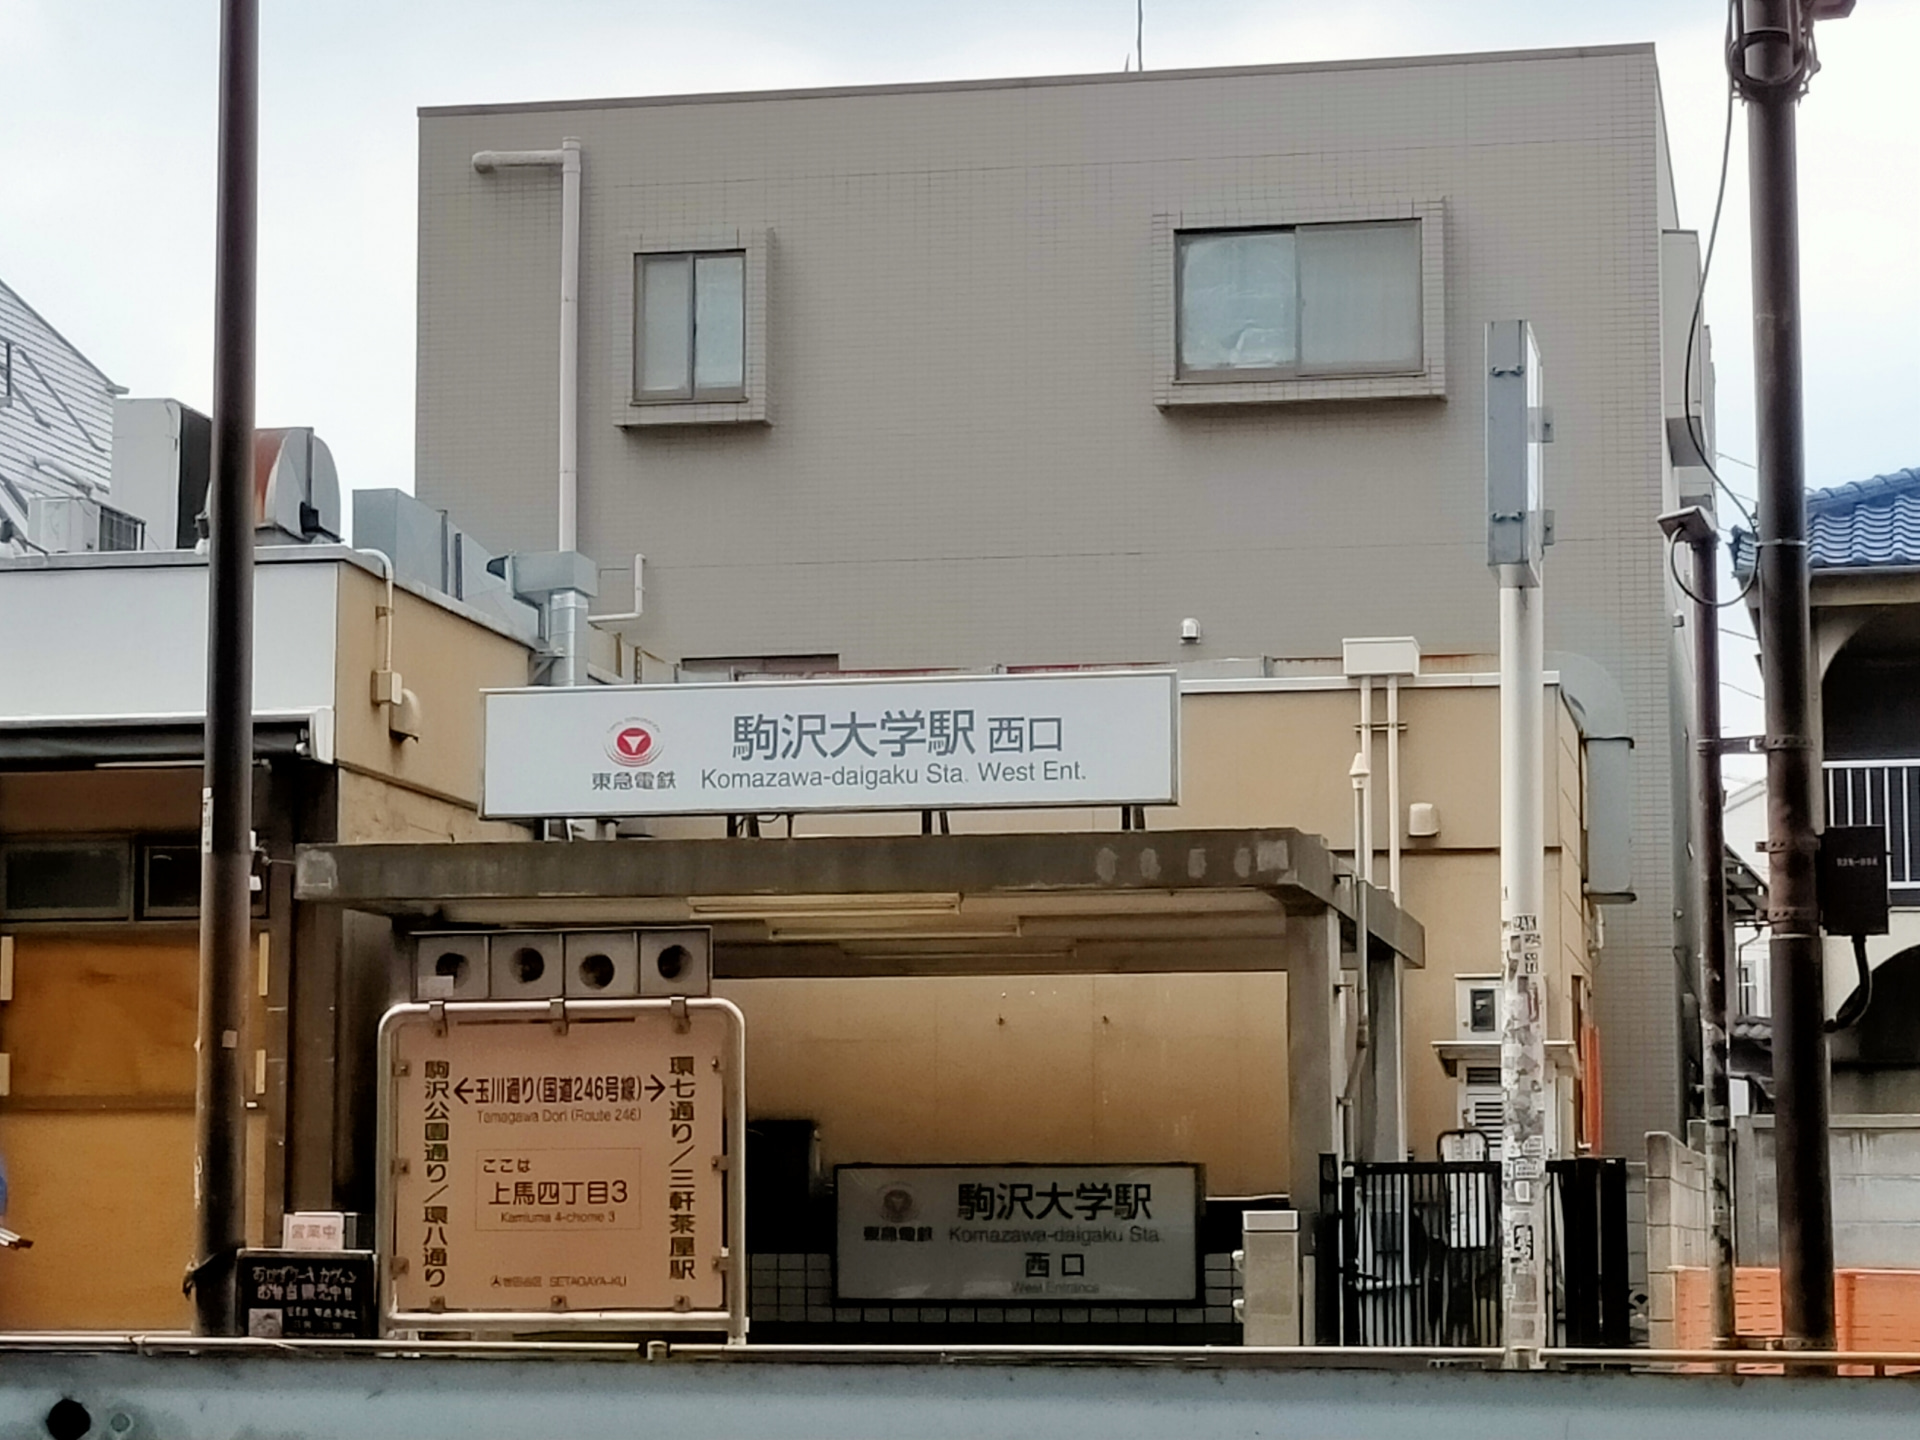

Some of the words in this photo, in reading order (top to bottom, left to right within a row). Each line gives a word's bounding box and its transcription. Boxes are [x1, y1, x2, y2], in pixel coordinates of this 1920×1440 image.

[732, 709, 976, 761] 駒沢大学駅
[987, 716, 1063, 753] 西口
[592, 770, 677, 792] 東急電鉄
[701, 765, 919, 791] Komazawa-daigaku
[926, 763, 969, 784] Sta.
[977, 761, 1036, 783] West
[1043, 760, 1087, 782] Ent.
[571, 1108, 611, 1123] (Route
[615, 1107, 642, 1122] 246)
[483, 1158, 531, 1174] ここは
[488, 1179, 628, 1206] 上馬四丁目3
[956, 1181, 1152, 1222] 駒沢大学駅
[555, 1211, 605, 1223] 4-chome
[608, 1210, 616, 1223] 3
[949, 1226, 1124, 1246] Komazawa-daigaku
[1024, 1251, 1085, 1278] 西口
